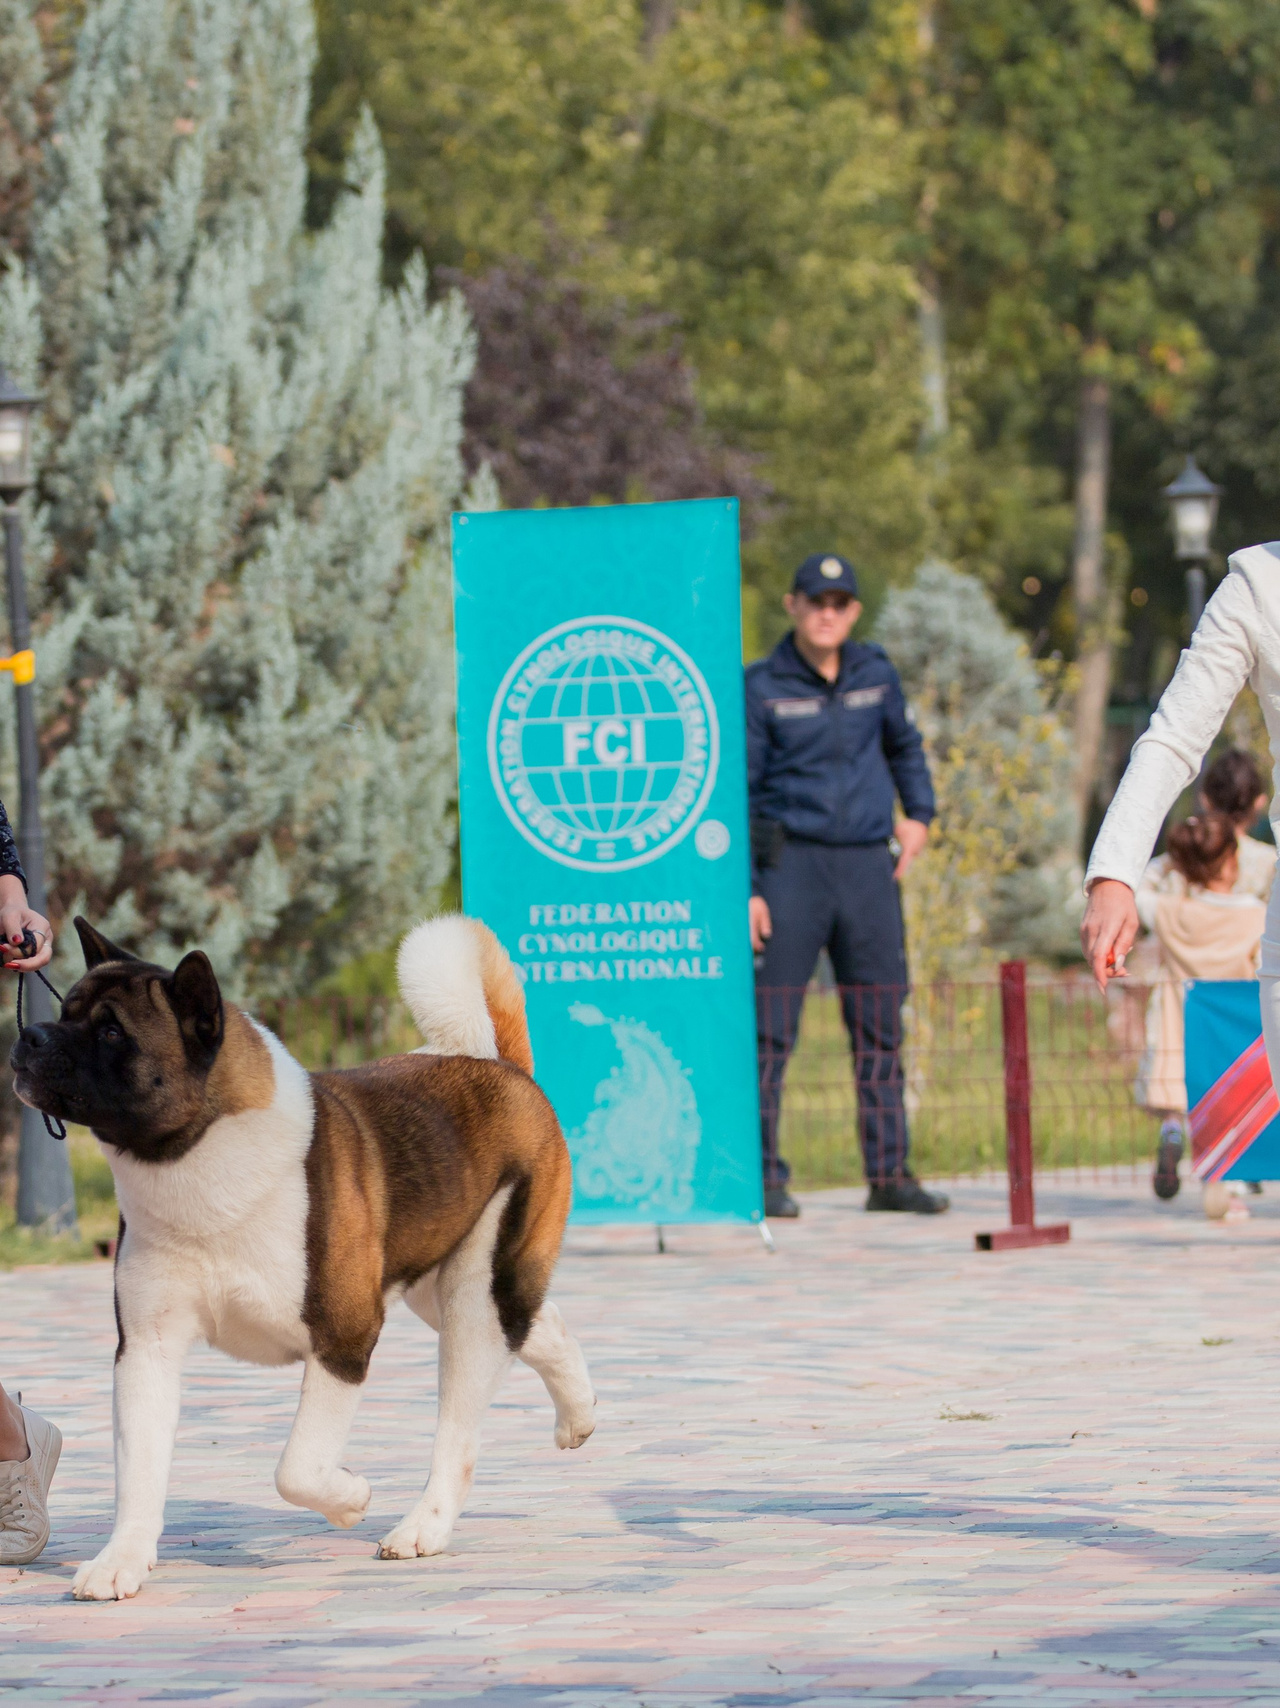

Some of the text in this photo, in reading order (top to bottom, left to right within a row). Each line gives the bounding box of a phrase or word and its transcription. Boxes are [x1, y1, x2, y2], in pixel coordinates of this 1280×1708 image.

[499, 629, 708, 854] FEDERATION CYNOLOGIQUE INTERNATIONALE
[562, 719, 647, 767] FCI
[529, 899, 692, 927] FEDERATION
[519, 928, 704, 954] CYNOLOGIQUE
[514, 956, 724, 983] NTERNATIONALE
